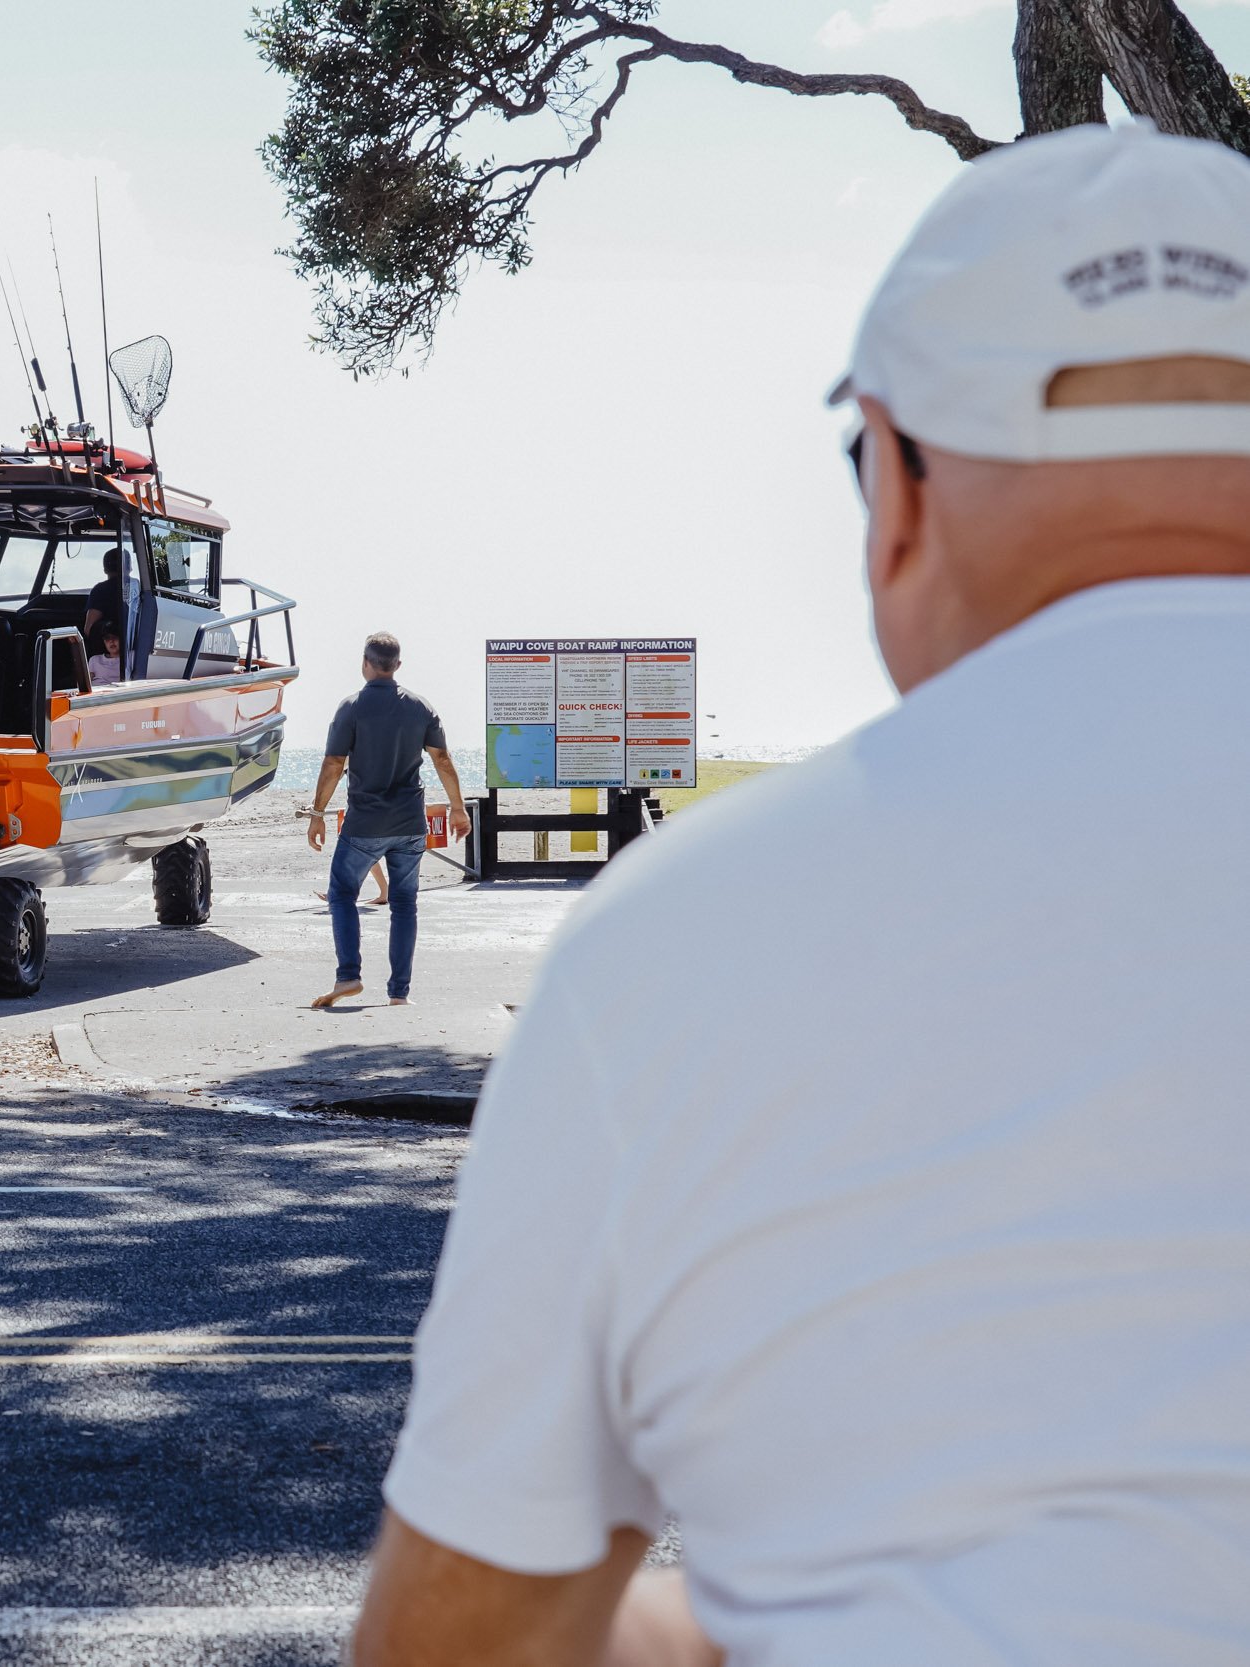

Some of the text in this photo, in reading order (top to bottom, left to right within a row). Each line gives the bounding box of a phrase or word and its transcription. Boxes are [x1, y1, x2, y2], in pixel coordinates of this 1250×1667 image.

[155, 630, 176, 648] 240
[490, 642, 692, 650] WAIPU COVE BOAT RAMP INFORMATION
